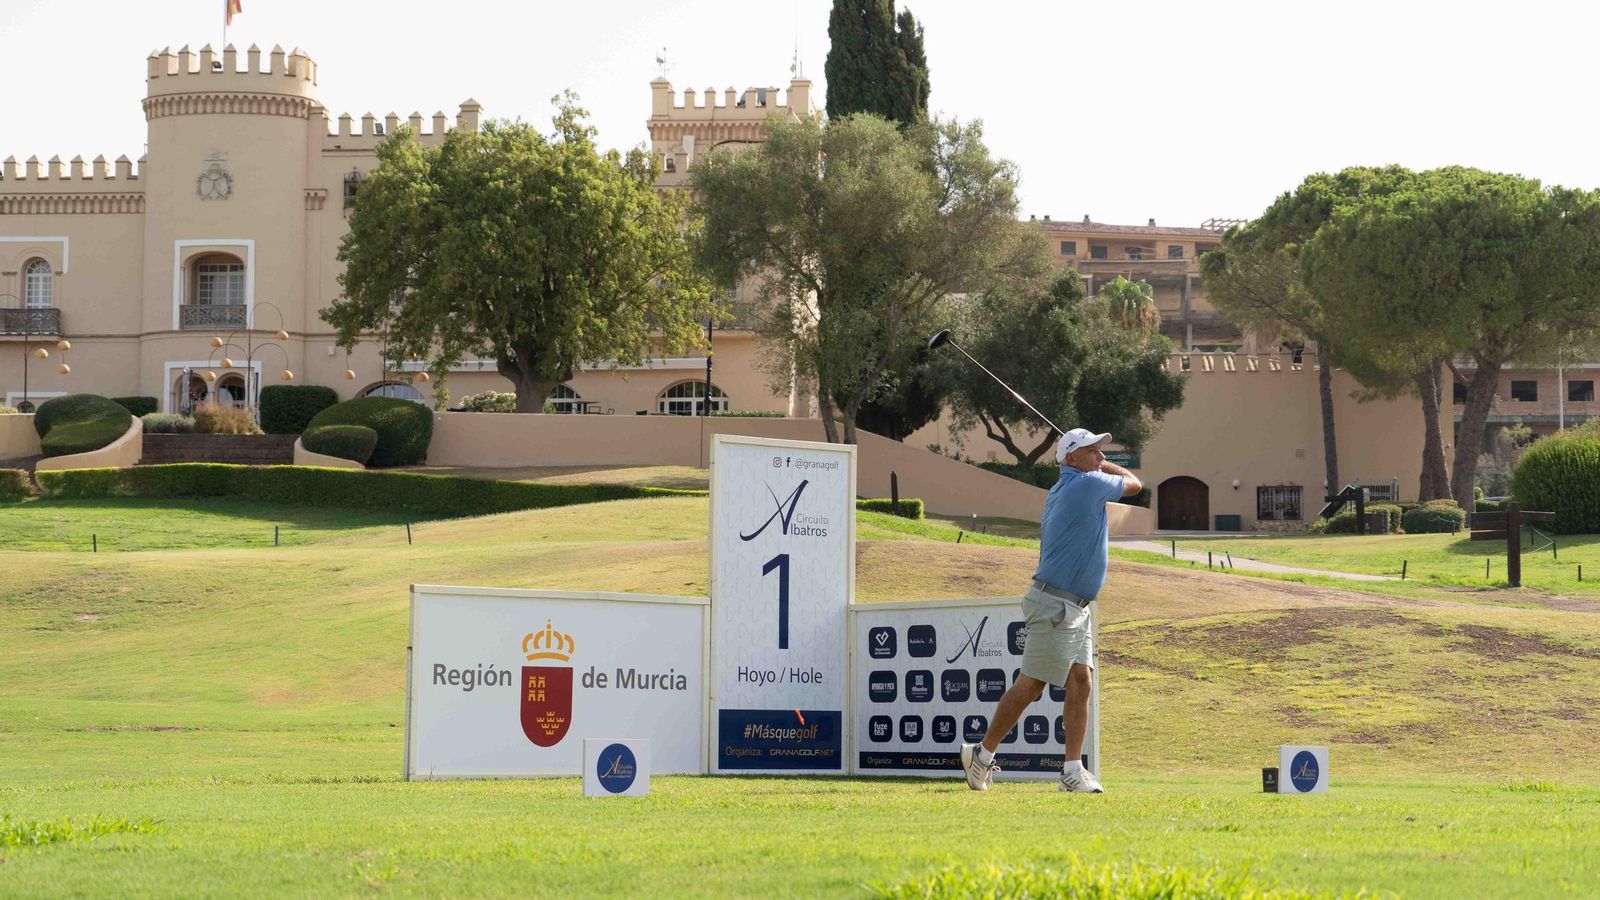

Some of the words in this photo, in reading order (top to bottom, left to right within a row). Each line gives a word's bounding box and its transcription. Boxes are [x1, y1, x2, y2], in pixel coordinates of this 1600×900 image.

[795, 458, 839, 471] @granagolf
[796, 513, 829, 525] Circuito
[762, 553, 790, 650] 1
[433, 663, 512, 692] Región
[582, 666, 608, 689] de
[616, 668, 687, 690] Murcia
[738, 666, 776, 687] Hoyo
[790, 667, 823, 684] Hole
[744, 724, 819, 743] #Másquegolf
[874, 721, 888, 731] fuze
